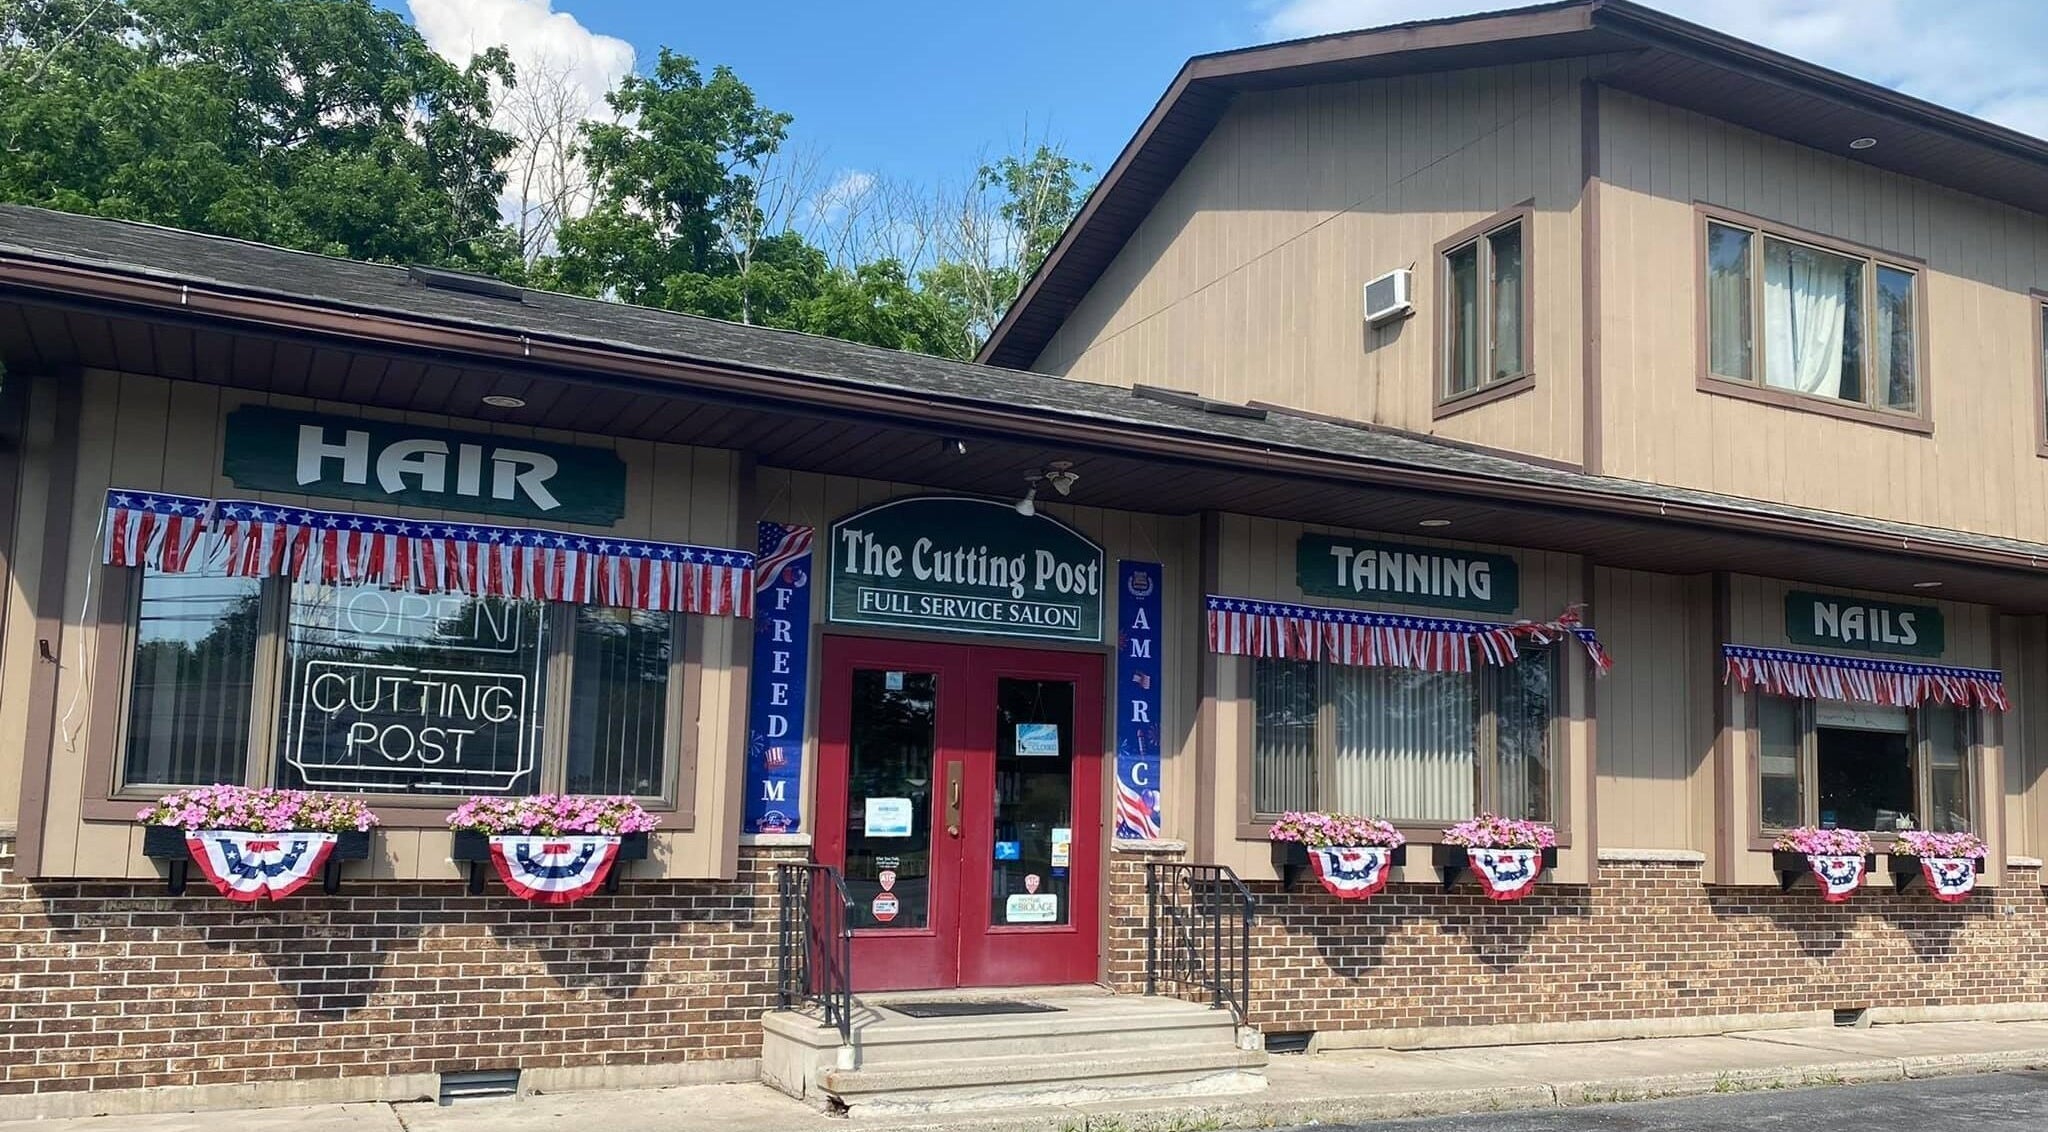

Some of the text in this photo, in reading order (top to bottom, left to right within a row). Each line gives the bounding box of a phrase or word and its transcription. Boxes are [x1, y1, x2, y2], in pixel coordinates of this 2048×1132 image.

[296, 424, 561, 511] HAIR
[842, 528, 1098, 599] The Cutting Post
[1330, 545, 1491, 601] TANNING
[347, 591, 511, 643] OPEN
[862, 591, 1079, 627] FULL SERVICE SALON
[1813, 601, 1918, 646] NAILS
[311, 672, 514, 723] CUTTING
[346, 721, 476, 764] POST
[1018, 902, 1055, 912] BIOLAGE
